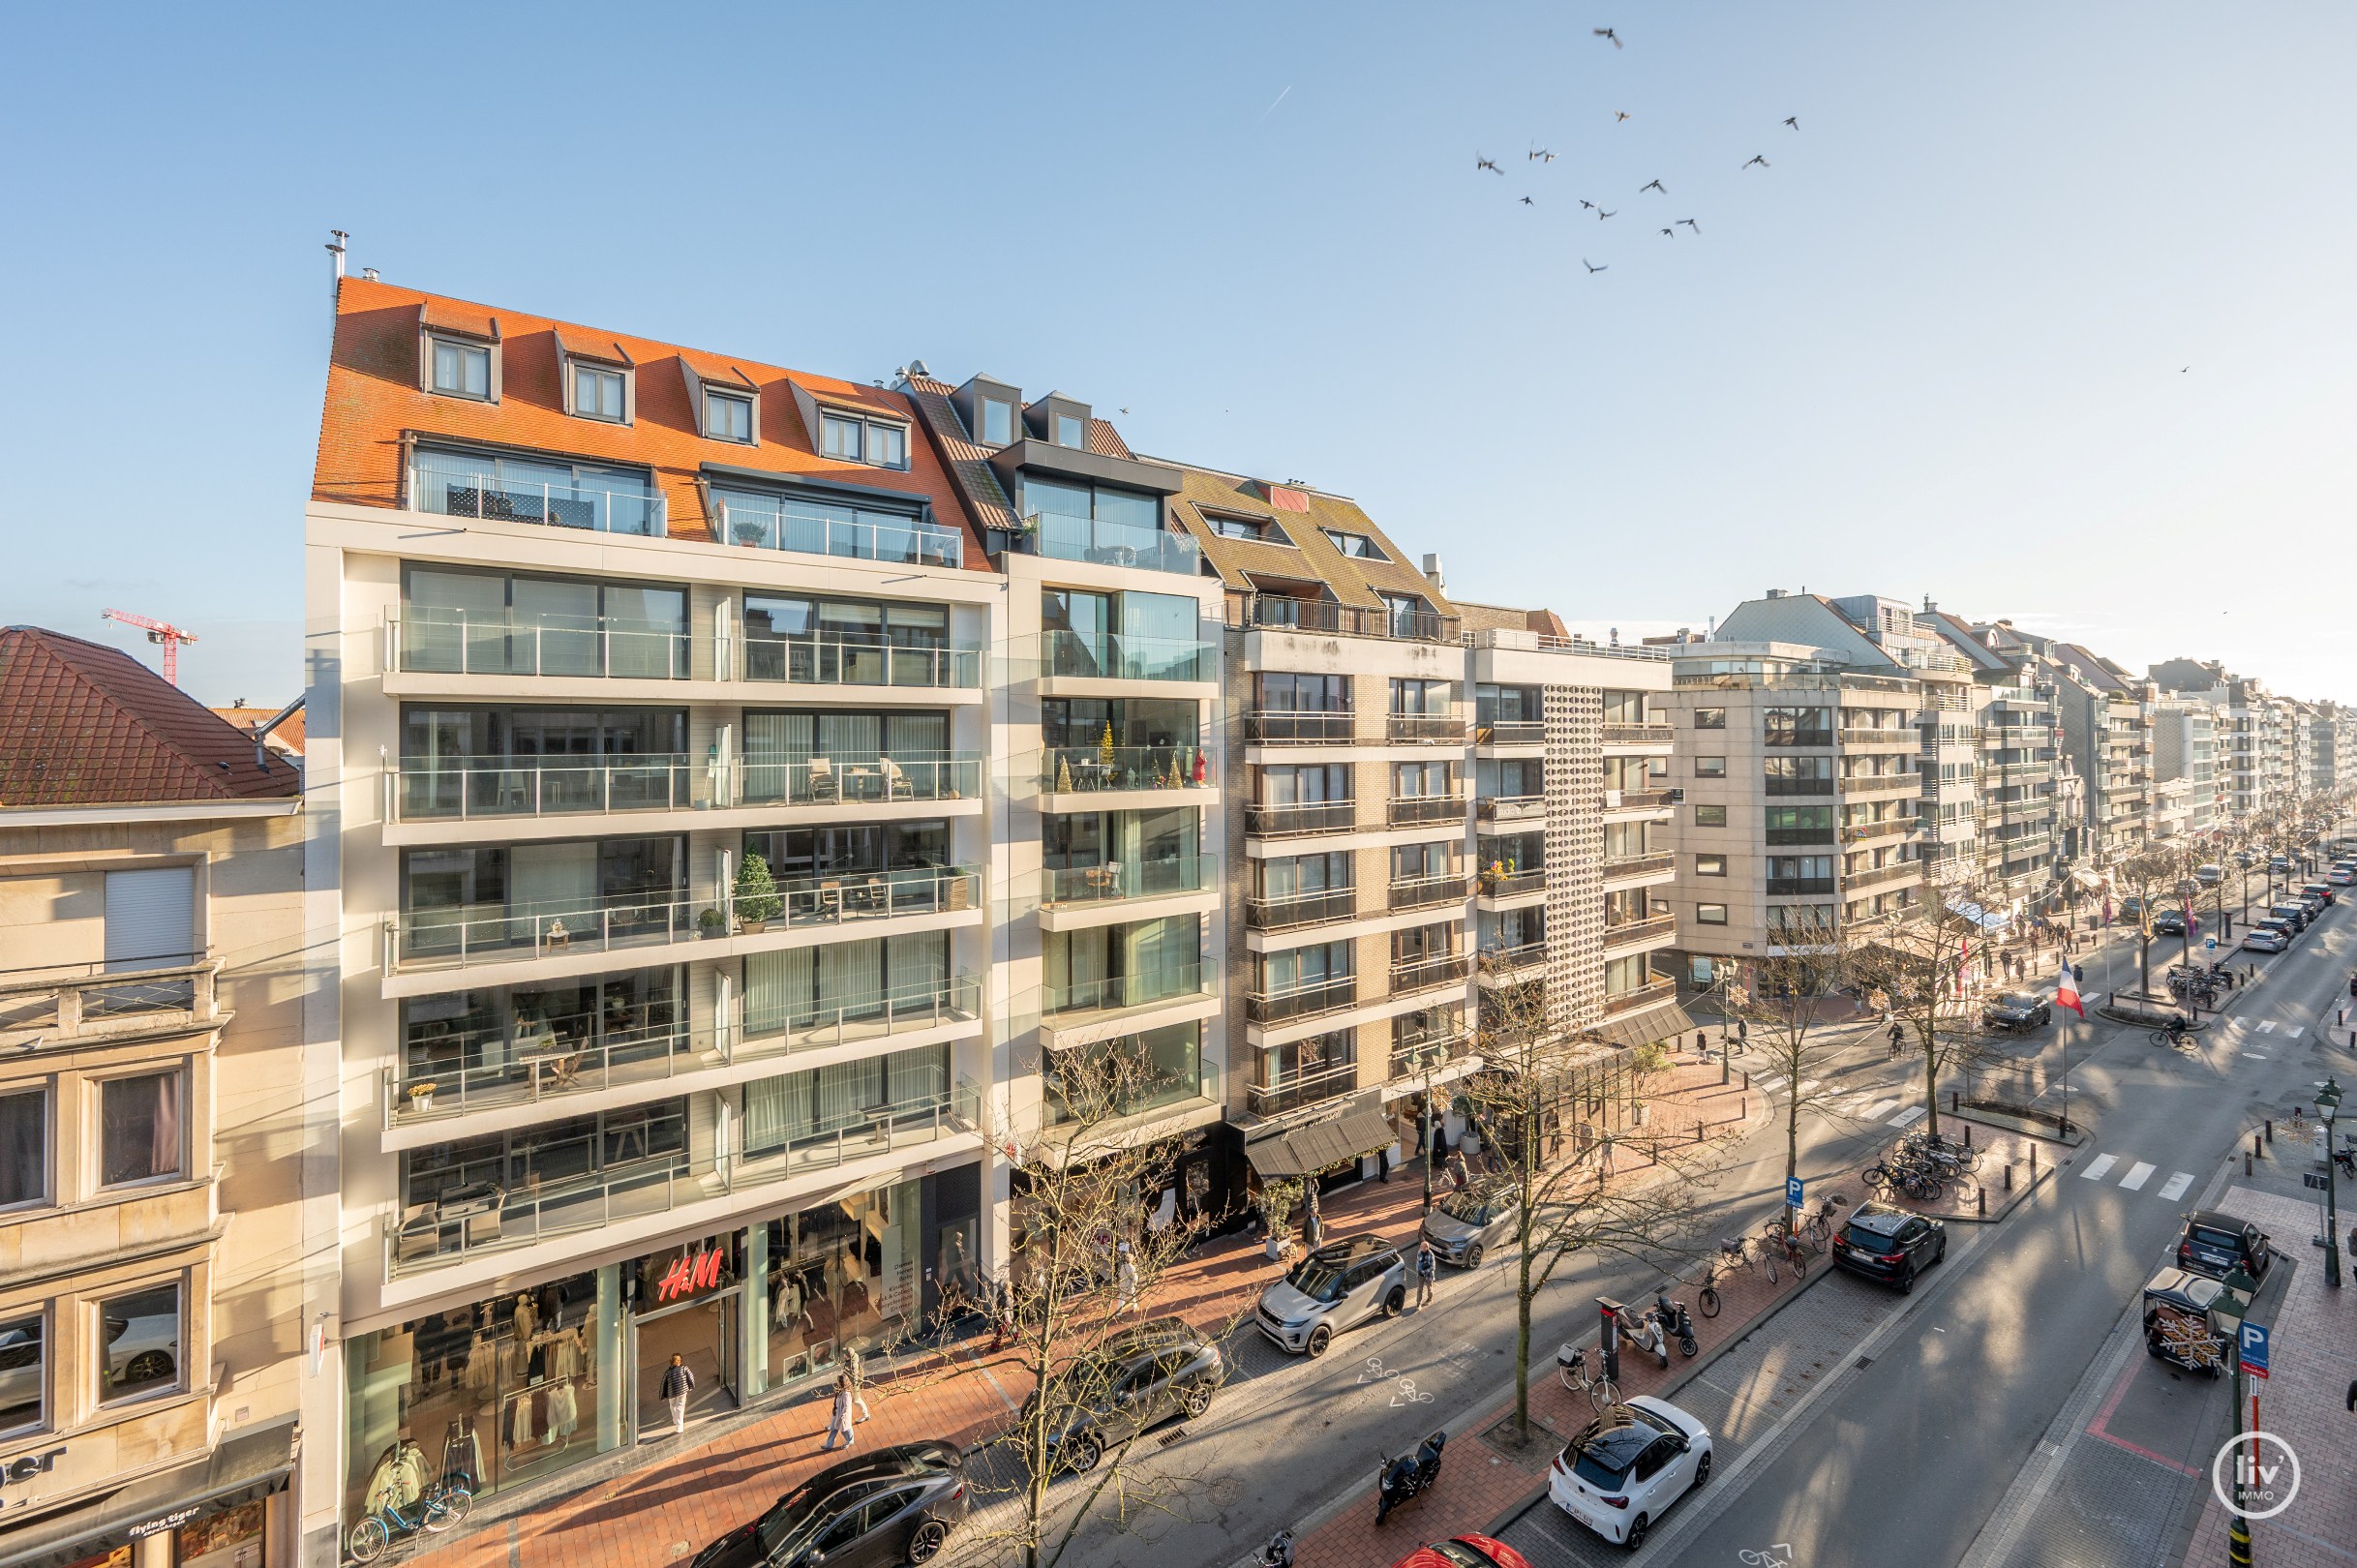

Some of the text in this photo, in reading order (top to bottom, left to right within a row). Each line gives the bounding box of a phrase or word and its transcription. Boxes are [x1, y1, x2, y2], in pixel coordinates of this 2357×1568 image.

[1789, 1179, 1801, 1196] P
[658, 1247, 723, 1302] H&M
[893, 1260, 914, 1270] Dames
[896, 1267, 914, 1276] Heren
[889, 1281, 914, 1292] Kinderen
[2243, 1325, 2264, 1349] P
[0, 1445, 68, 1491] er
[128, 1506, 200, 1537] flying tiger
